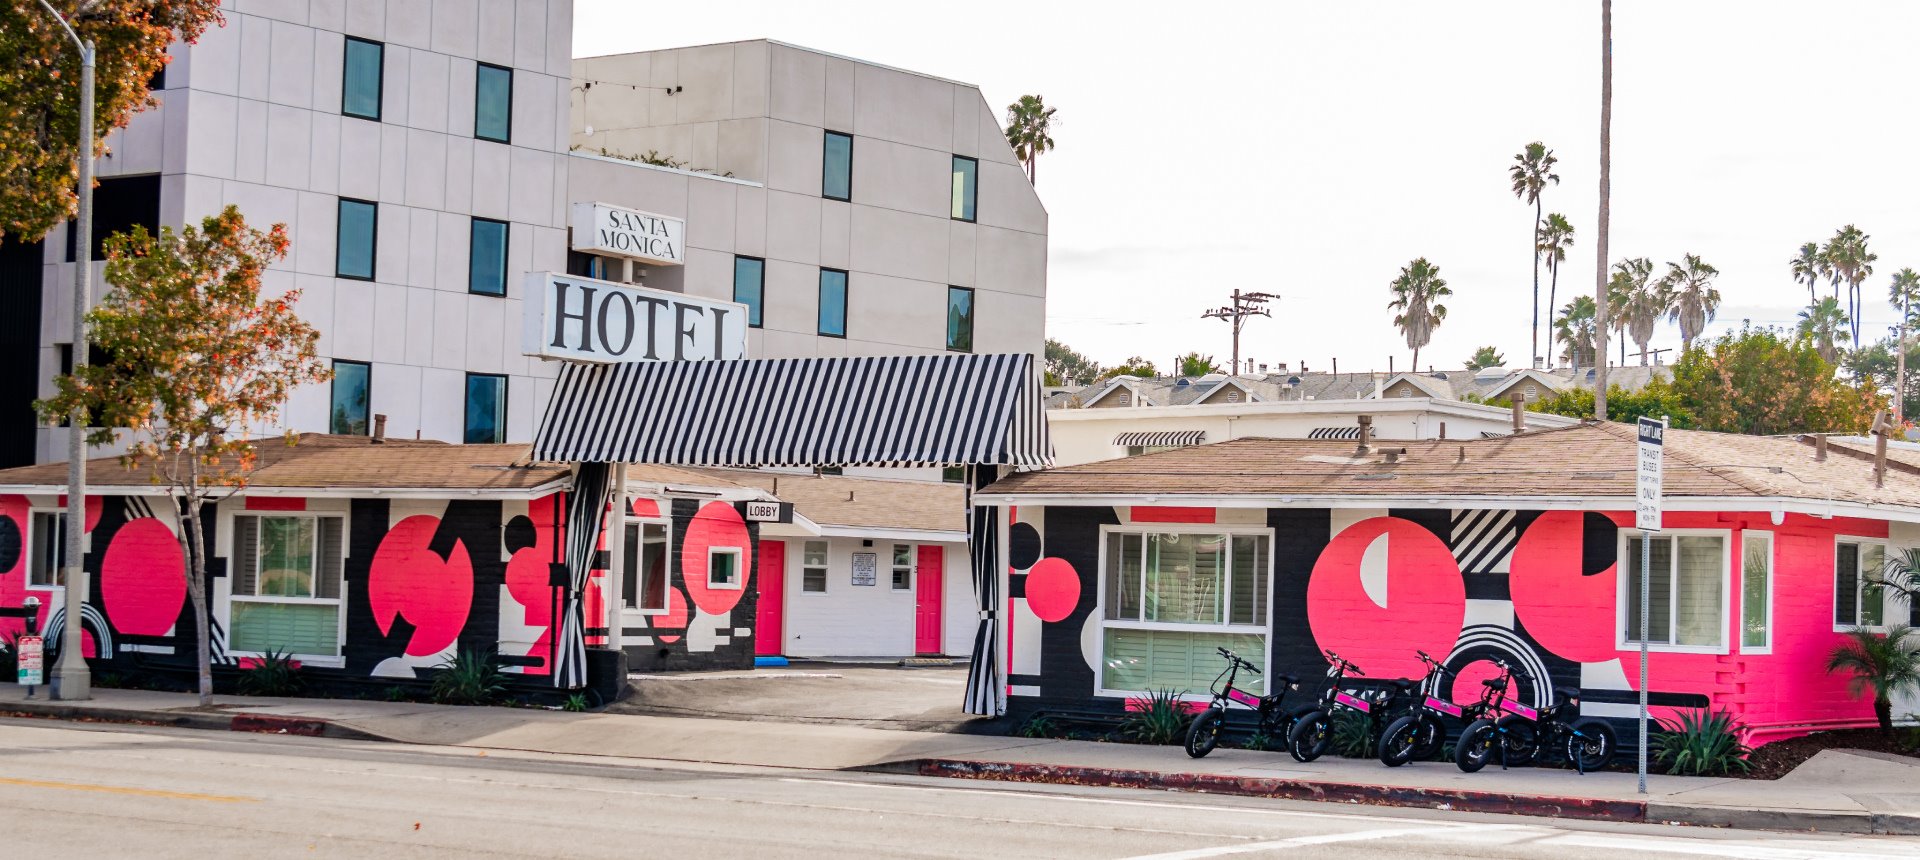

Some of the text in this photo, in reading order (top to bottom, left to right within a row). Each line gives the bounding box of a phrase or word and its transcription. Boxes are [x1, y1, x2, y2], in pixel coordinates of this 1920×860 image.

[609, 210, 669, 238] SANTA
[600, 229, 676, 259] MONICA
[550, 281, 743, 361] HOTEL
[1651, 426, 1662, 440] LANE
[1641, 447, 1659, 460] TRANSIT
[1642, 461, 1657, 472] BUSES
[1643, 488, 1656, 500] ONLY
[749, 505, 777, 517] LOBBY
